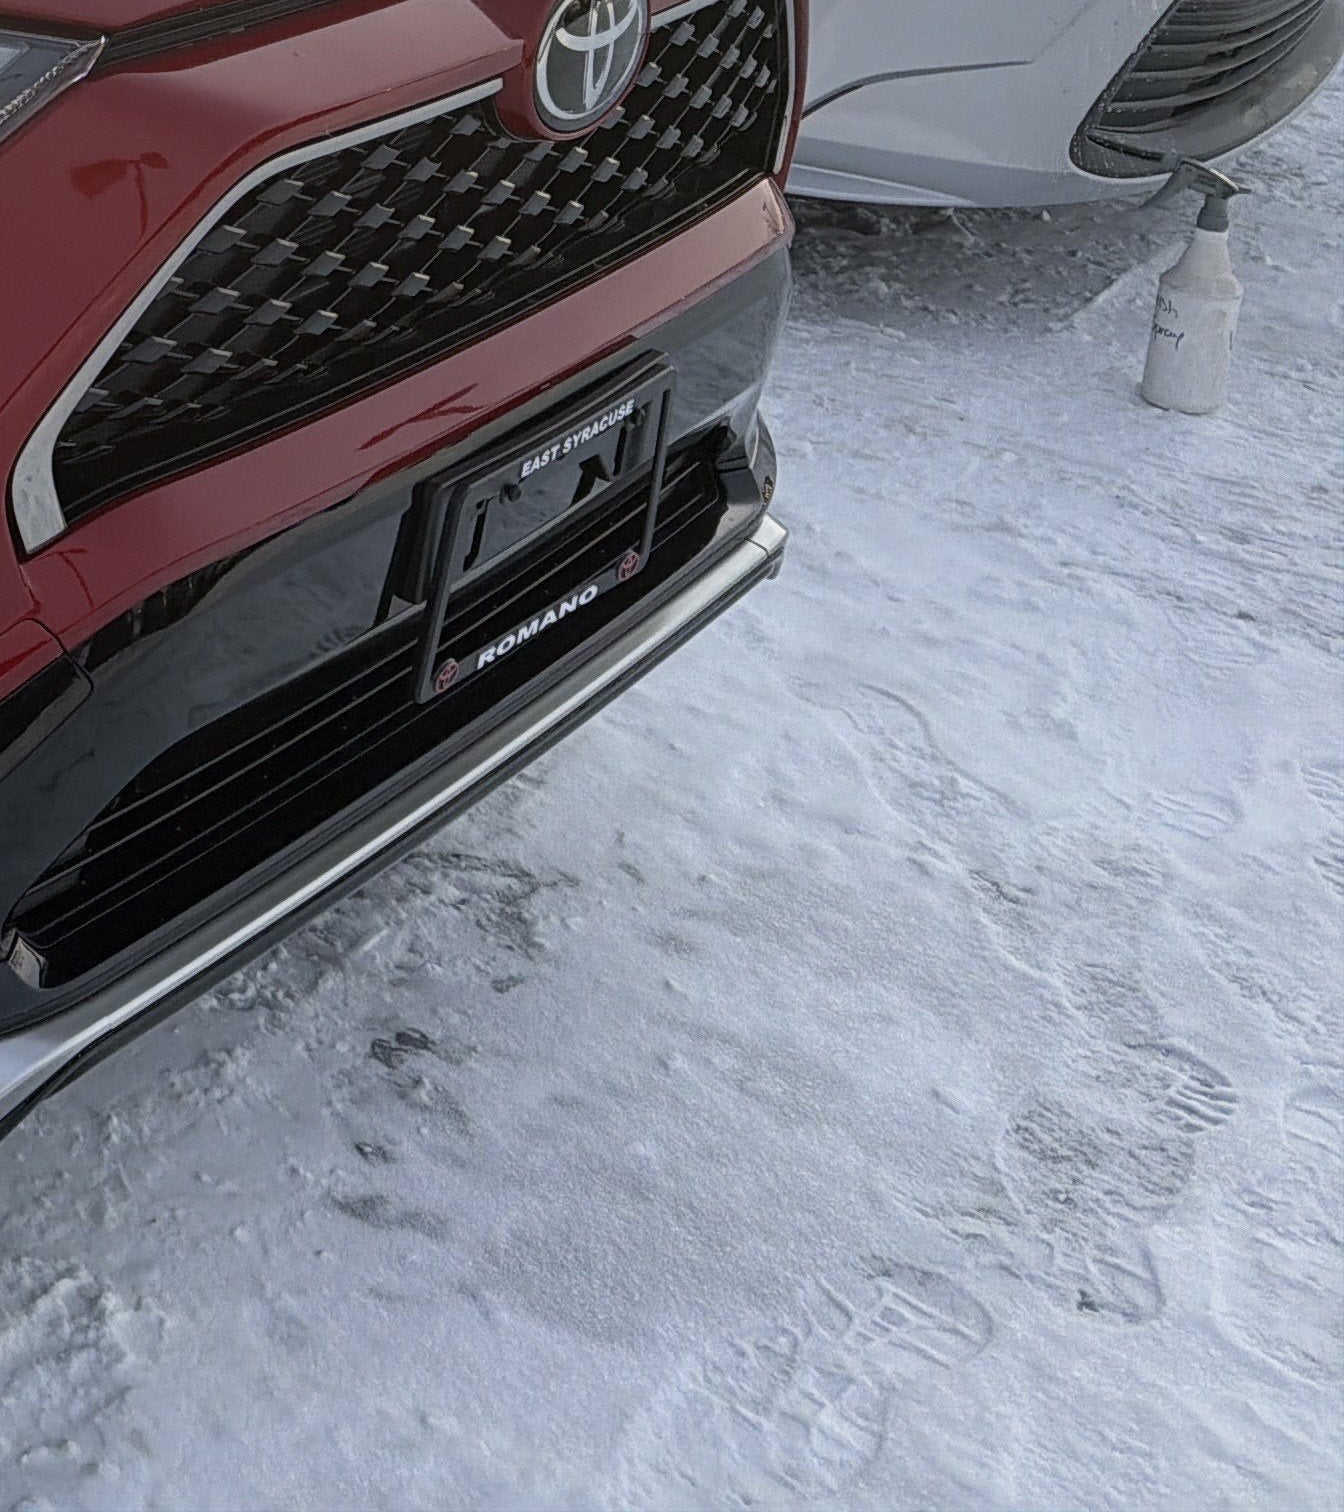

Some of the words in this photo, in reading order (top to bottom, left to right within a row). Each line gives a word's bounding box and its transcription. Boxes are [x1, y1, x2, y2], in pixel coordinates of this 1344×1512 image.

[520, 444, 561, 479] EAST
[562, 398, 635, 454] SYRACUSE
[476, 584, 599, 670] ROMANO
